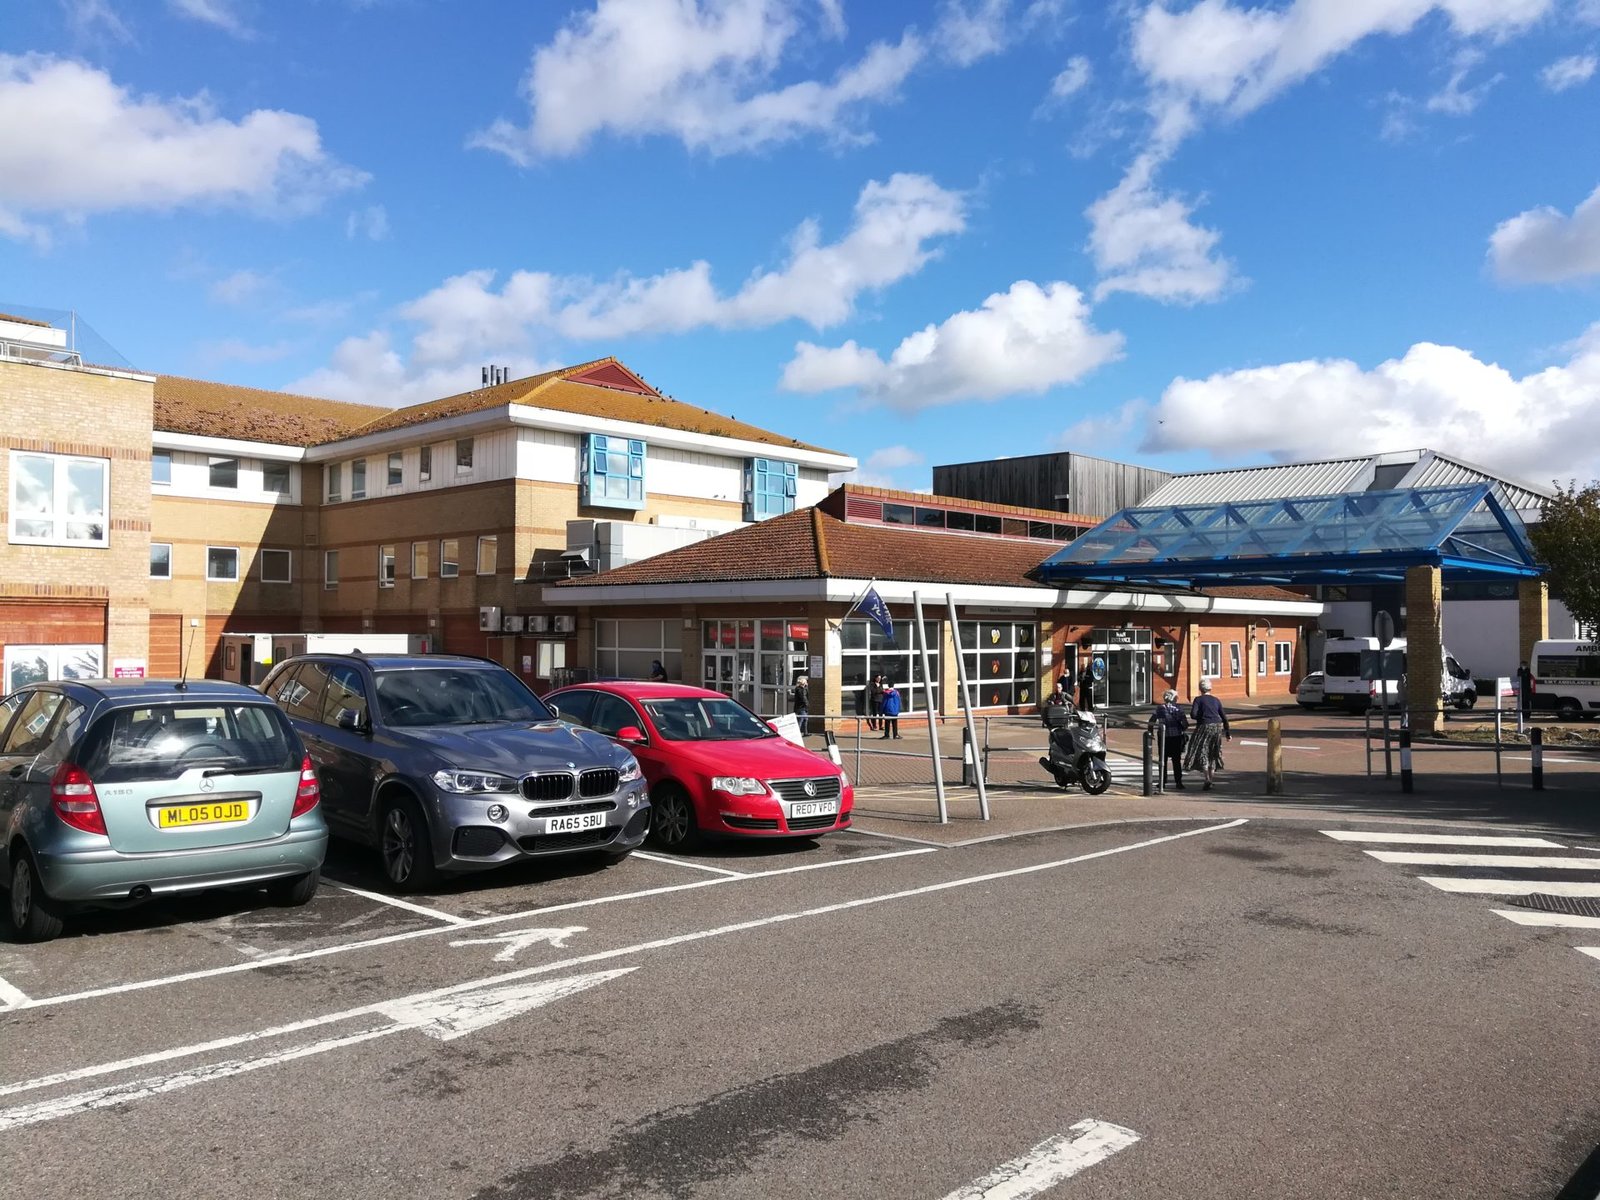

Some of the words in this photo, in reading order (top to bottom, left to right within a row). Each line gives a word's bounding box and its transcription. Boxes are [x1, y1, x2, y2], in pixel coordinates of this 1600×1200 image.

[167, 807, 209, 823] ML05
[213, 804, 242, 819] OJD
[796, 804, 817, 815] RE07
[551, 816, 580, 831] RA65
[583, 814, 602, 828] SBU
